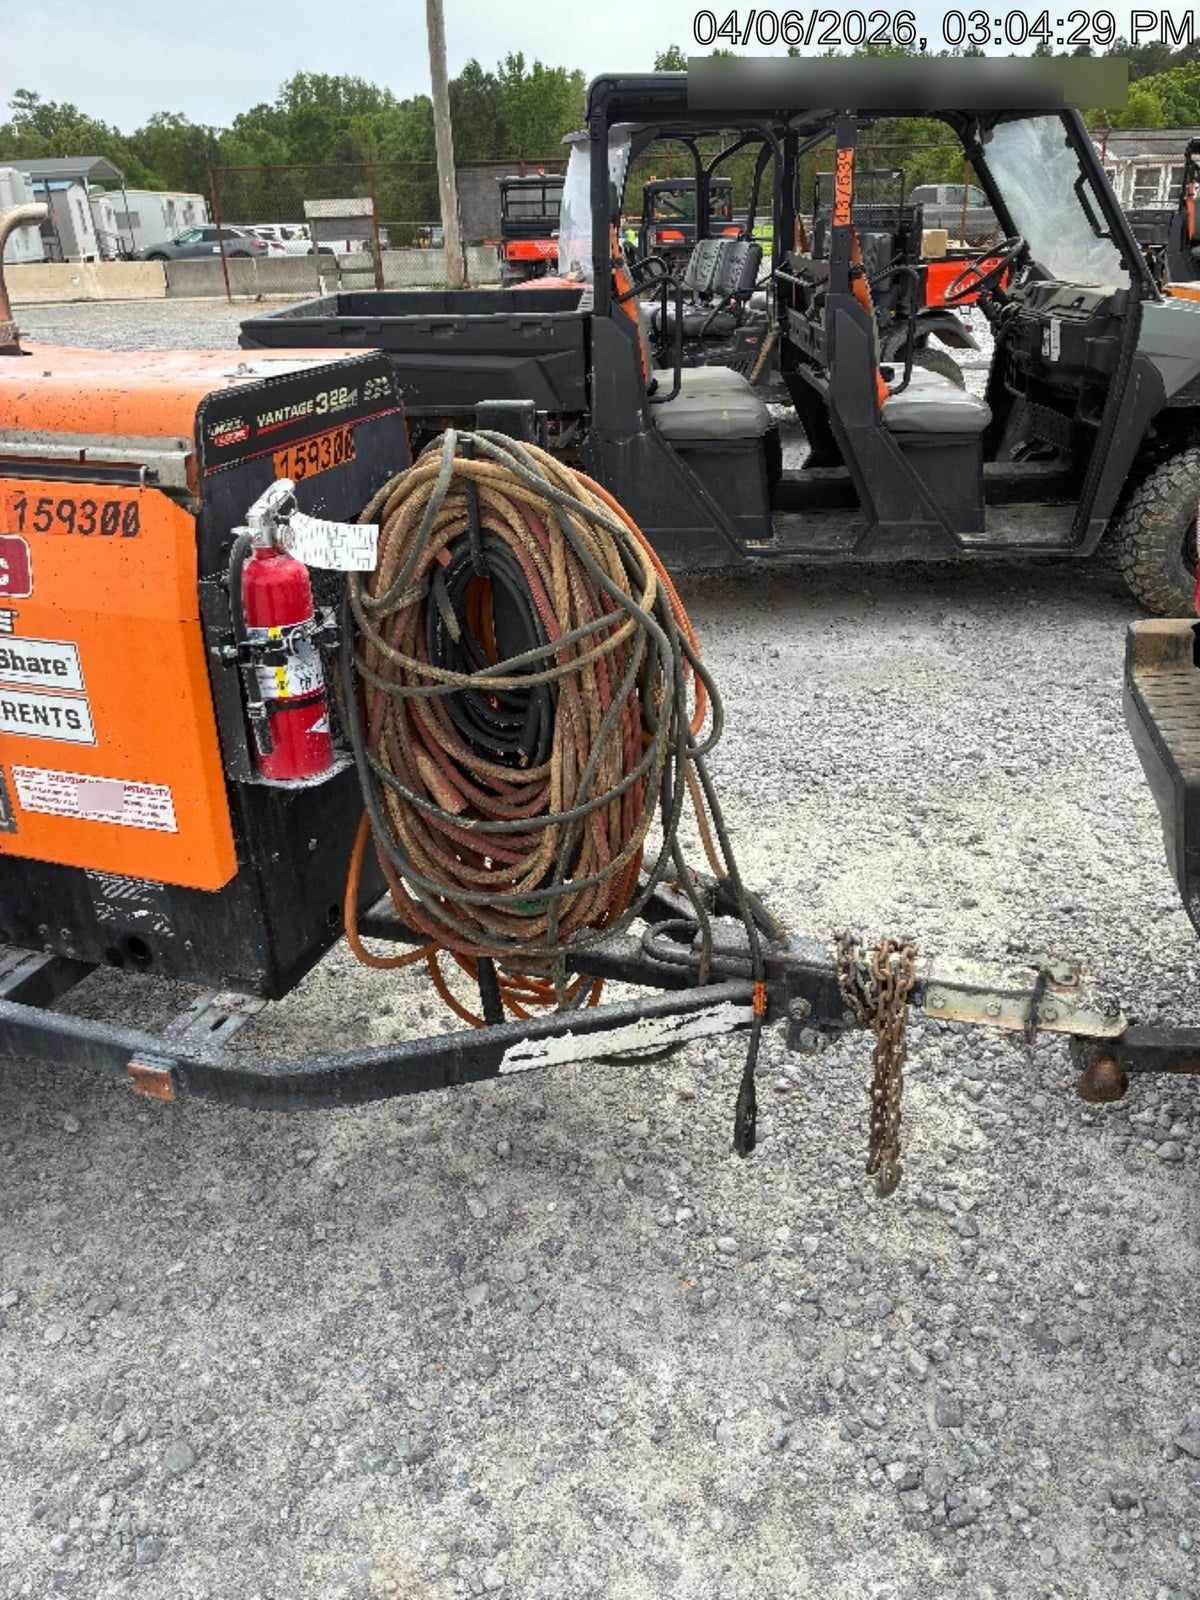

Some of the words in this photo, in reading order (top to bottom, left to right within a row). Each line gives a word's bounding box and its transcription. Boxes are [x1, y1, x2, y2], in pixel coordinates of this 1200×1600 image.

[256, 399, 314, 428] VANTAGE
[280, 428, 355, 481] 159300
[13, 497, 140, 537] 159300
[1, 701, 81, 729] RENTS
